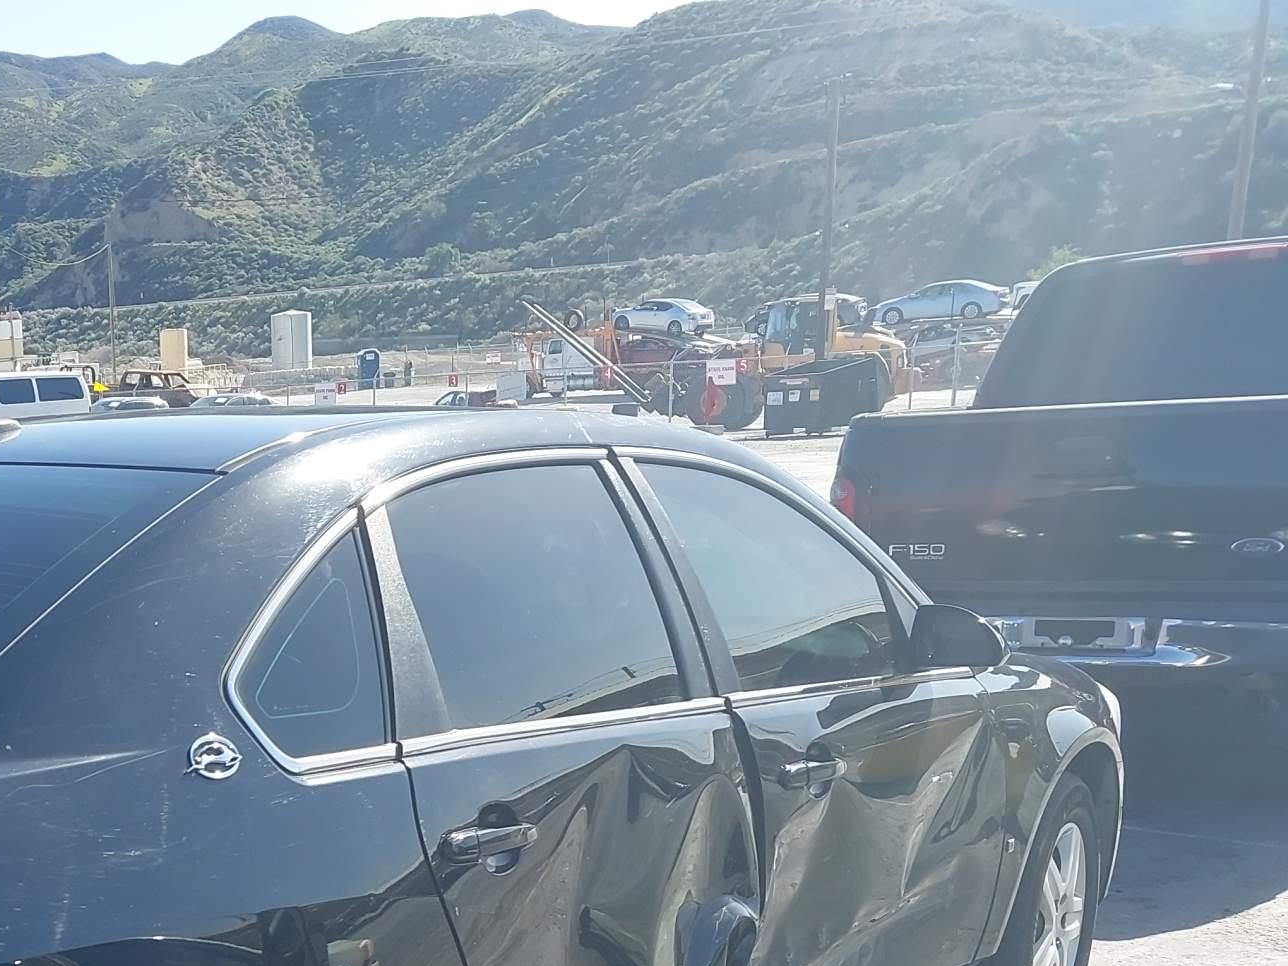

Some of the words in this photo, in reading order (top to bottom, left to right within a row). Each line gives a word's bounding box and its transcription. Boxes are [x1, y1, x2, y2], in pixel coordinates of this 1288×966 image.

[740, 359, 748, 371] 5
[450, 375, 457, 387] 3
[888, 544, 946, 556] F-150
